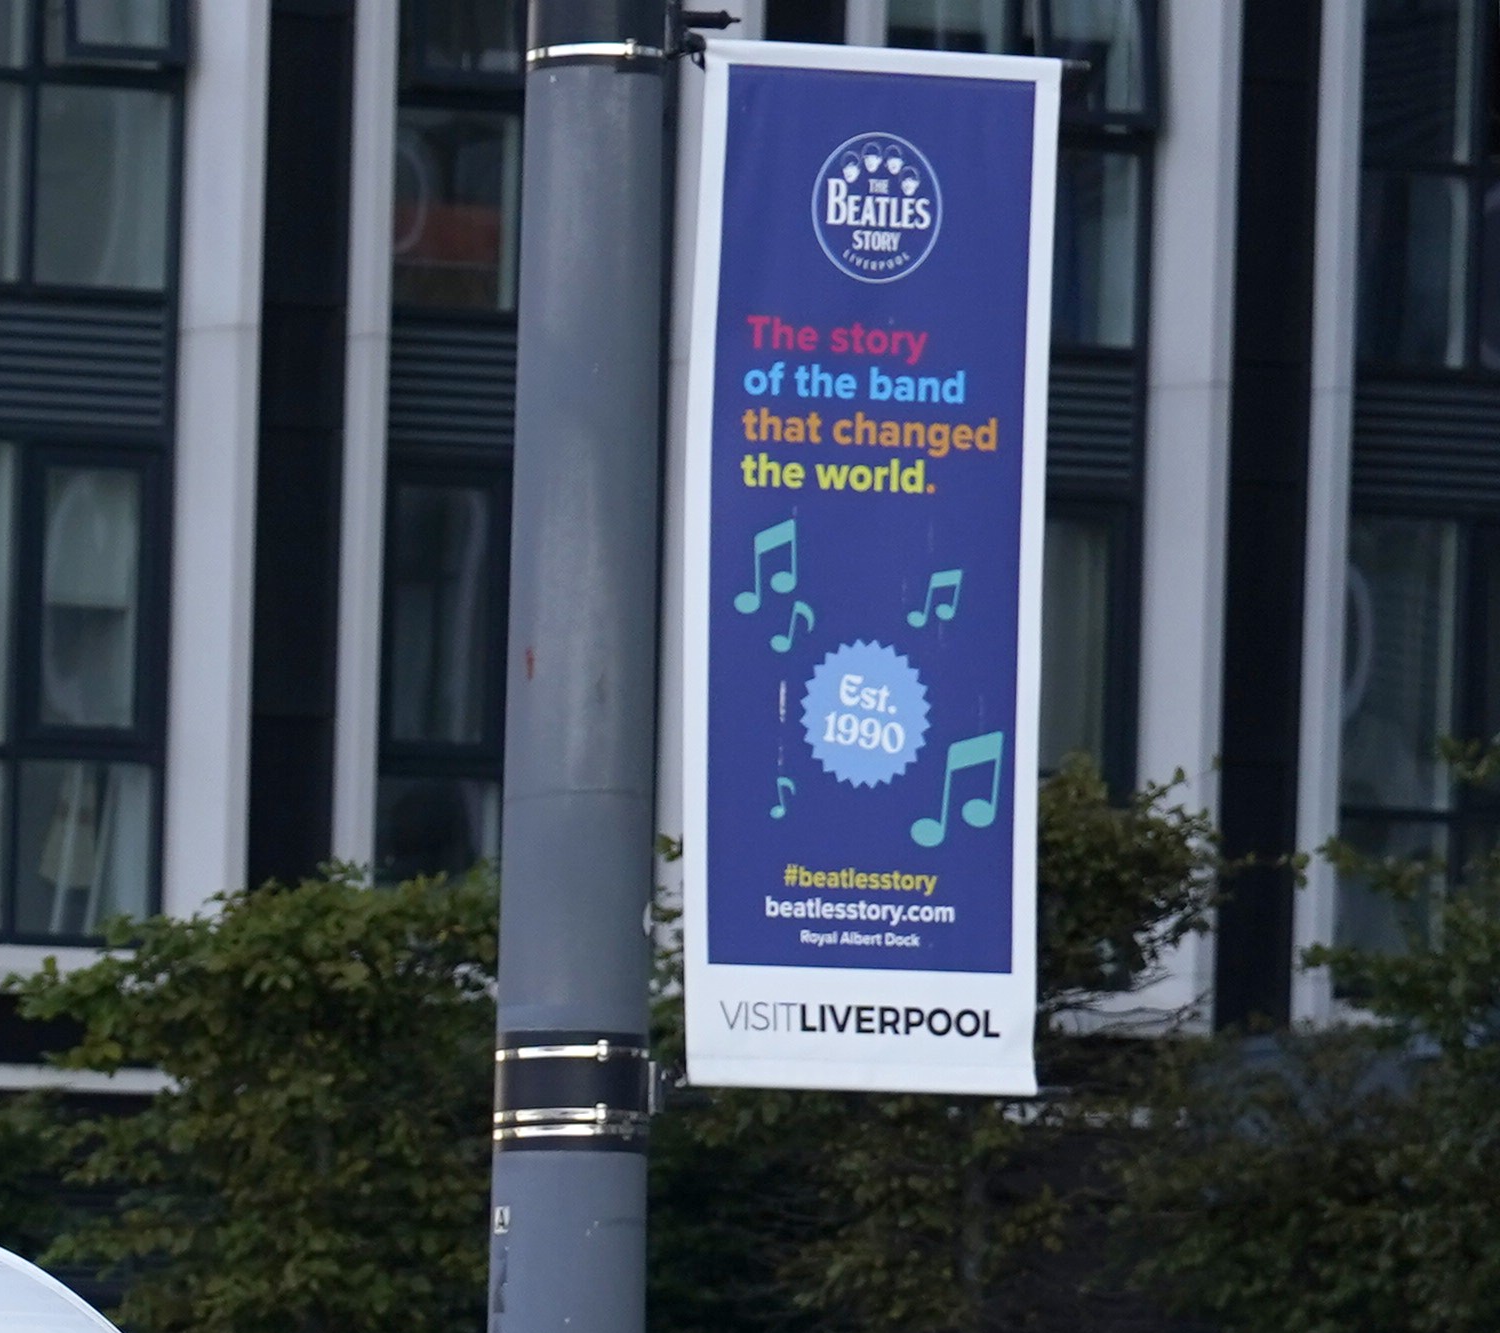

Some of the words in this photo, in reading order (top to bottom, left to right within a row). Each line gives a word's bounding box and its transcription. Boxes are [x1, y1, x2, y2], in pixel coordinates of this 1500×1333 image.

[826, 178, 931, 229] BEATLES
[852, 230, 901, 252] STORY
[747, 316, 818, 351] The
[830, 323, 927, 365] story
[744, 362, 785, 396] of
[794, 365, 856, 399] the
[869, 367, 965, 403] band
[742, 408, 821, 443] that
[833, 412, 997, 457] changed
[741, 453, 804, 488] the
[816, 458, 936, 494] world.
[838, 674, 896, 715] Est.
[823, 711, 905, 753] 1990
[784, 864, 938, 897] #beatlesstory
[765, 895, 955, 926] beatlesstory.com
[800, 929, 838, 947] Royal
[840, 931, 882, 946] Albert
[885, 932, 920, 947] Dock
